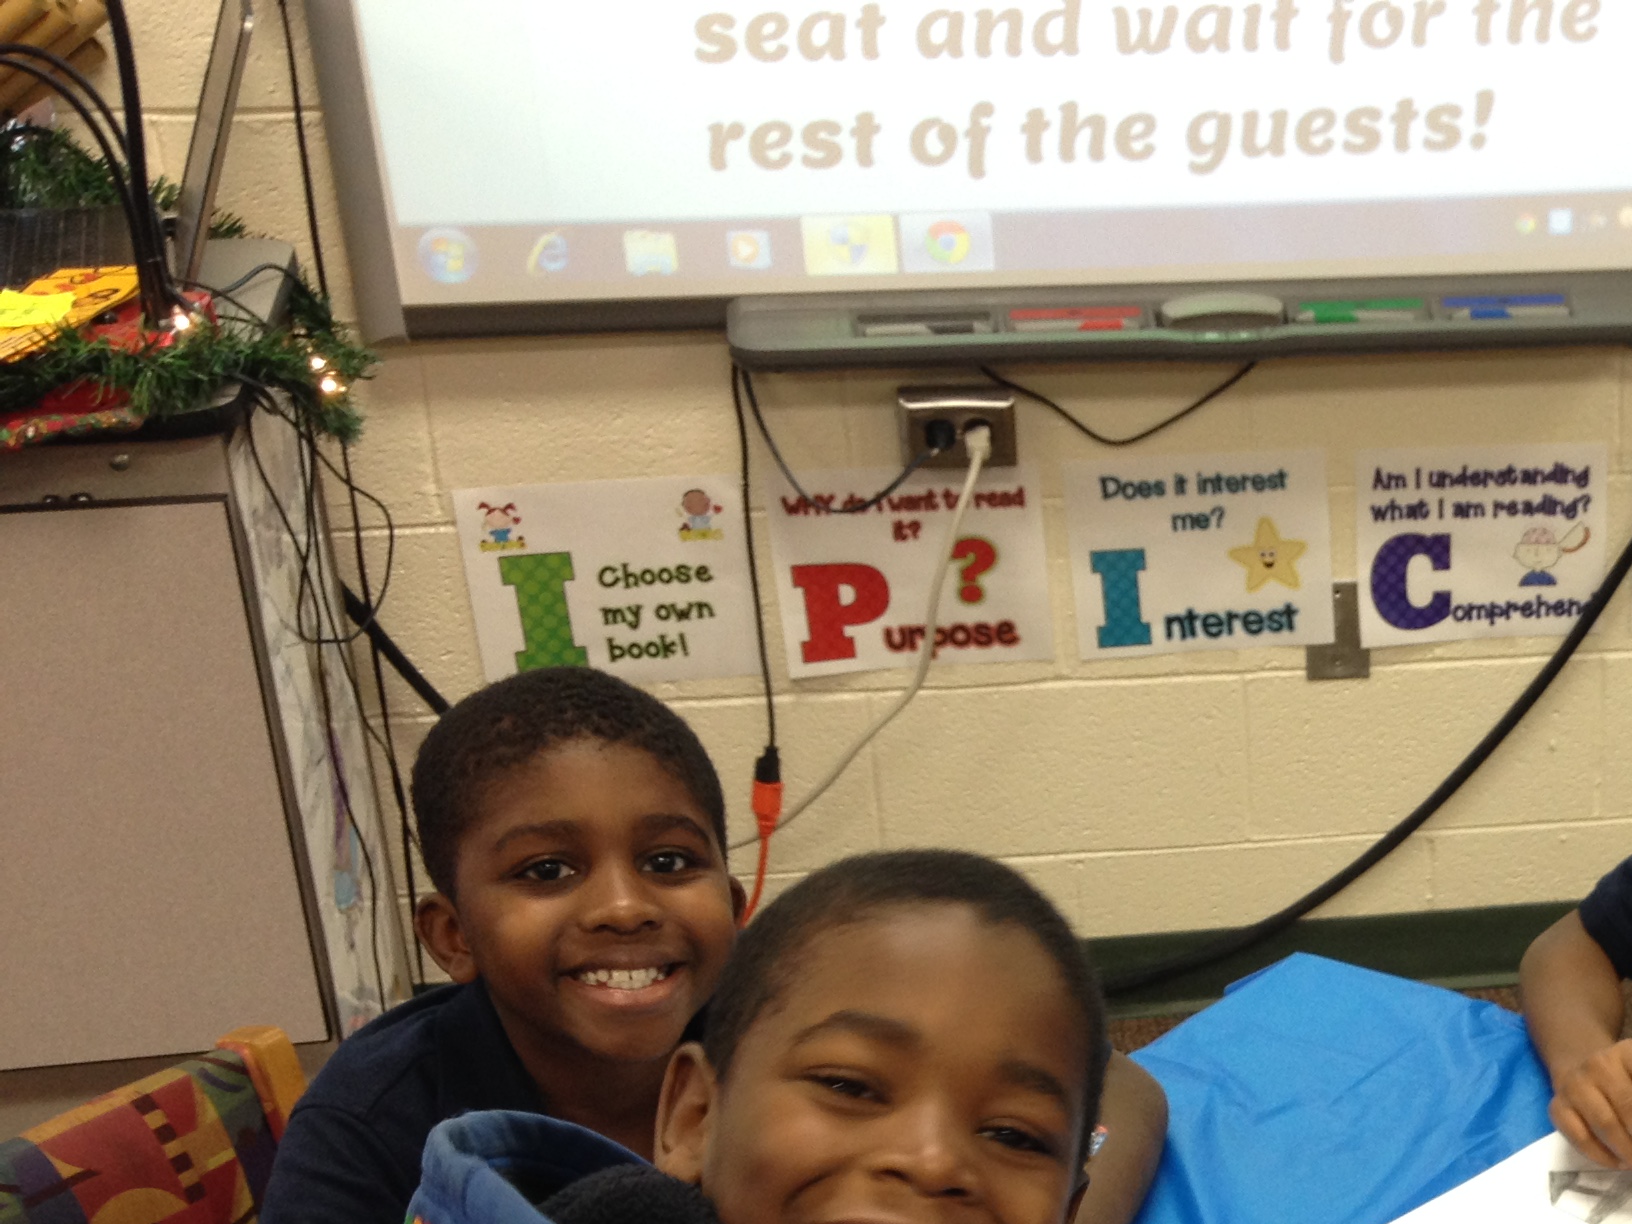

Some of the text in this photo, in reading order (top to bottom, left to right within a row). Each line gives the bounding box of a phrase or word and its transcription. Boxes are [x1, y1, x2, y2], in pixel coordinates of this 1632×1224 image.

[694, 0, 1600, 64] seat and wait for the
[708, 89, 1496, 180] rest of the guests!
[1099, 468, 1289, 501] Does it interest
[1371, 461, 1592, 490] Am I understanding
[887, 487, 940, 512] want
[973, 485, 1027, 510] read
[1370, 493, 1593, 523] what I am reading?
[1171, 505, 1227, 532] me?
[498, 552, 714, 673] I Choose
[600, 600, 716, 631] my own
[606, 632, 689, 662] book!
